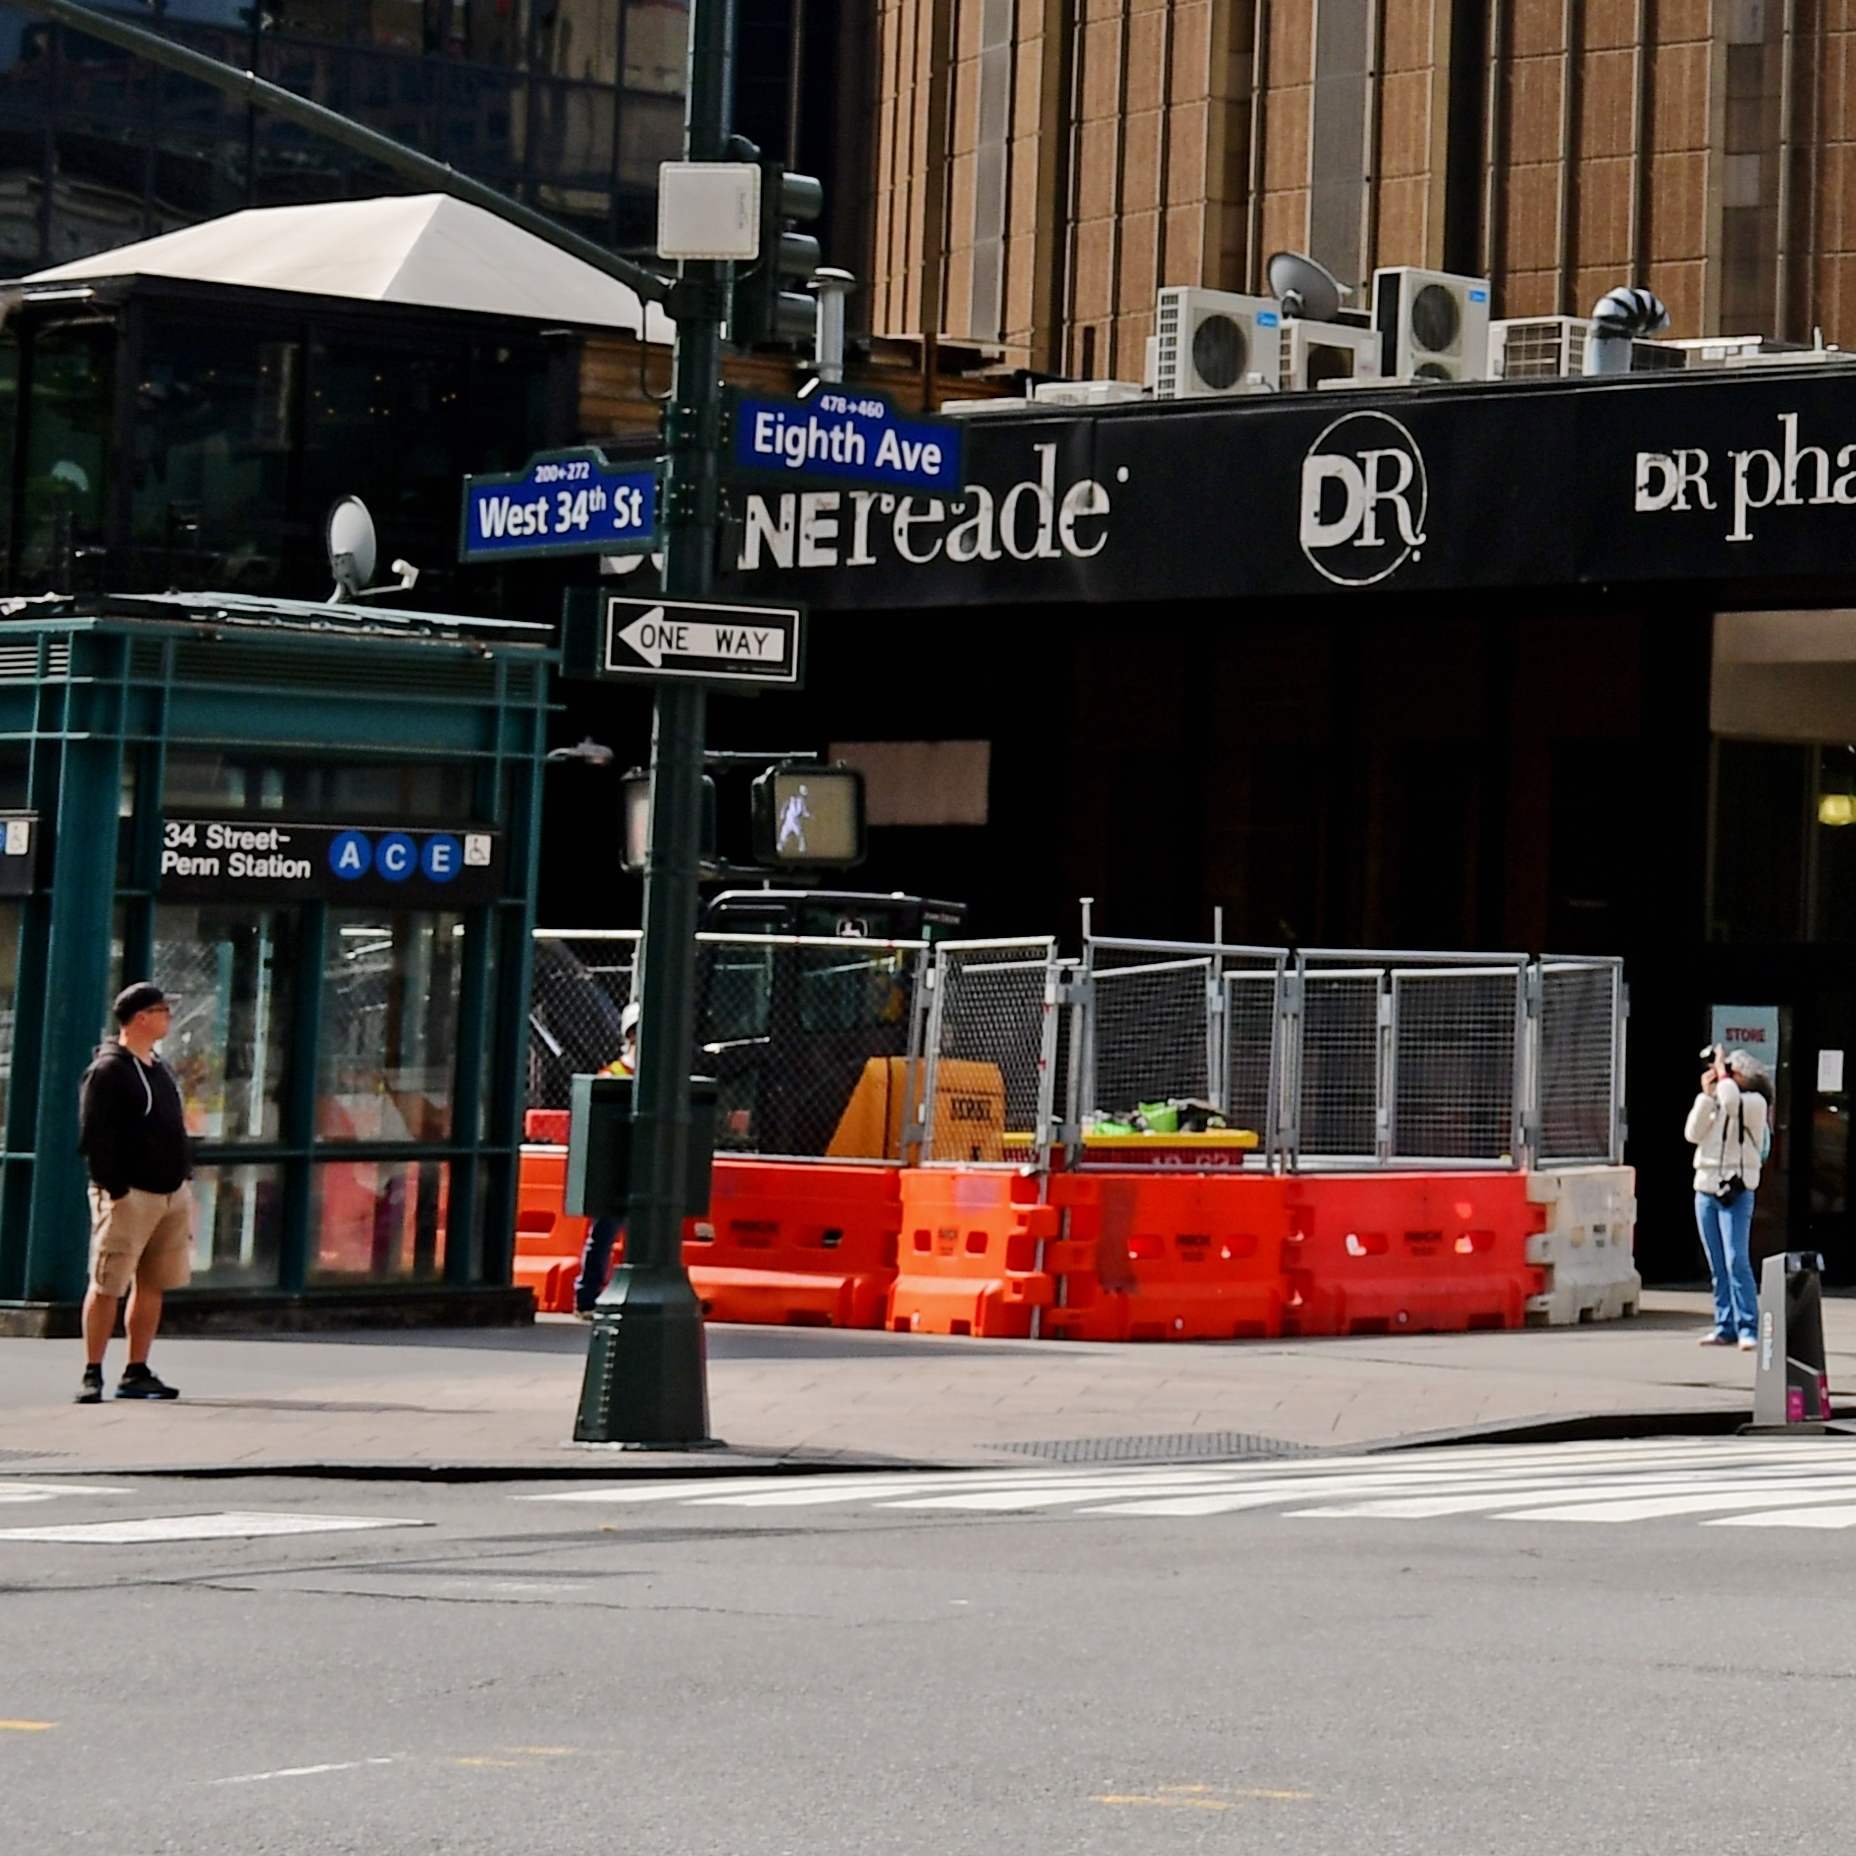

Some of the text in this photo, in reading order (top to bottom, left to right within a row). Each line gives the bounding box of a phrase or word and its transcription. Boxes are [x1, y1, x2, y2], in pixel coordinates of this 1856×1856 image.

[819, 394, 885, 419] 478 460
[754, 411, 943, 475] Eighth Ave
[534, 461, 590, 483] 200 272
[1634, 448, 1717, 512] DR
[478, 485, 644, 538] West 34th St
[1300, 447, 1427, 548] DR
[639, 623, 770, 655] ONE WAY
[163, 822, 198, 849] 34
[161, 851, 312, 880] Penn Station
[339, 841, 451, 872] A C E
[1724, 1026, 1767, 1043] STORE
